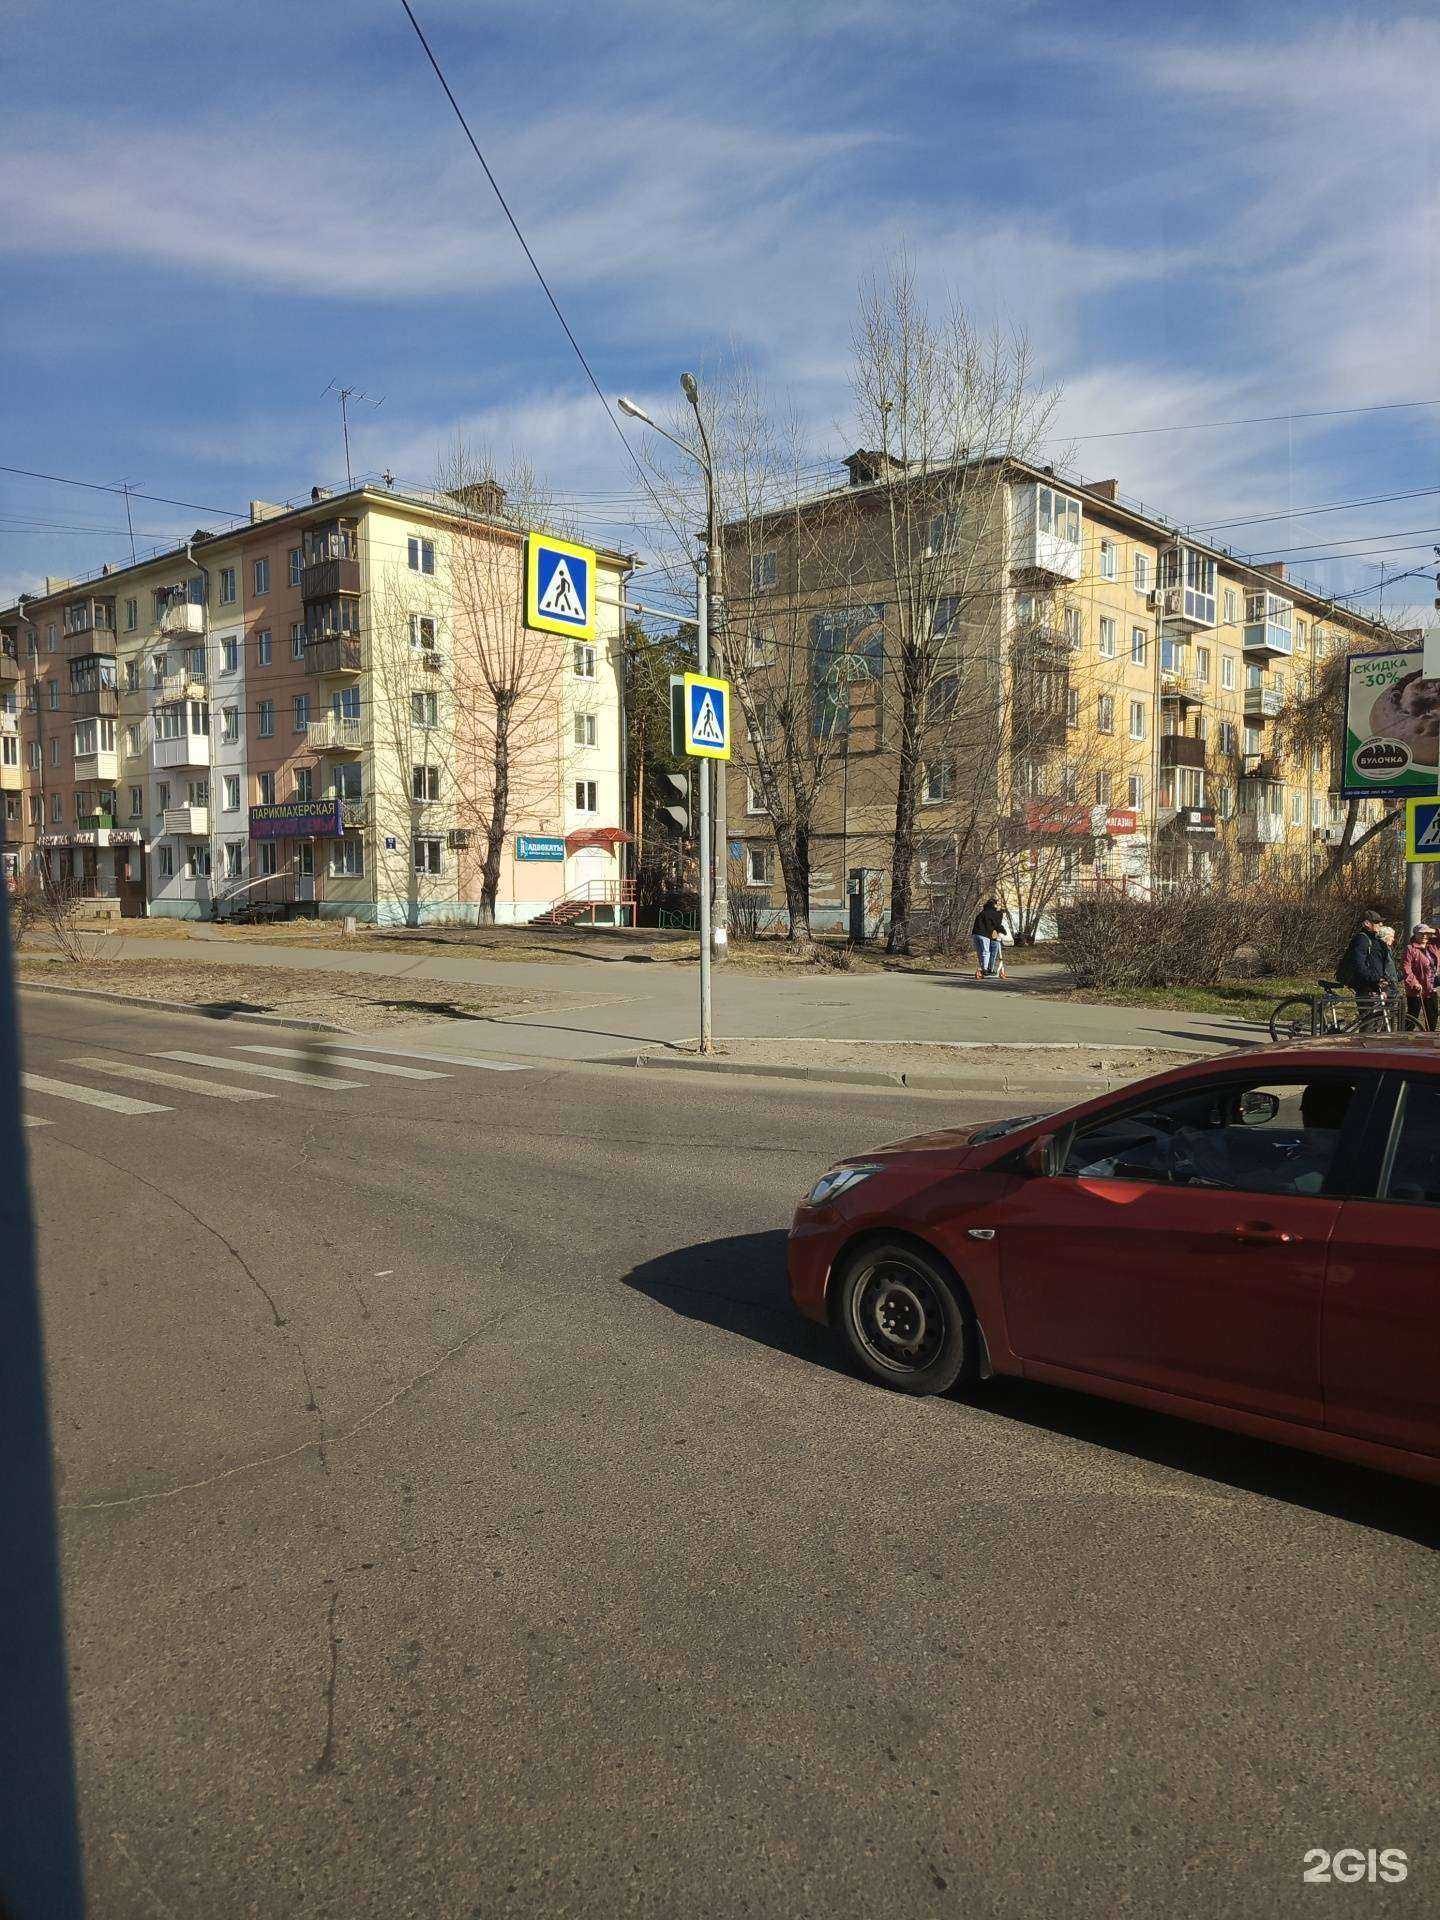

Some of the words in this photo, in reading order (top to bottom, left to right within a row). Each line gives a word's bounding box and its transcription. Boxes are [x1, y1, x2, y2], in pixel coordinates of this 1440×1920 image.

[1353, 659, 1407, 674] СКИДКА
[1359, 672, 1400, 687] -30%
[1360, 756, 1404, 765] БУЛОЧКА
[252, 803, 335, 820] ПАРИКМАХЕРСКАЯ
[528, 843, 563, 851] АДВОКАТЫ
